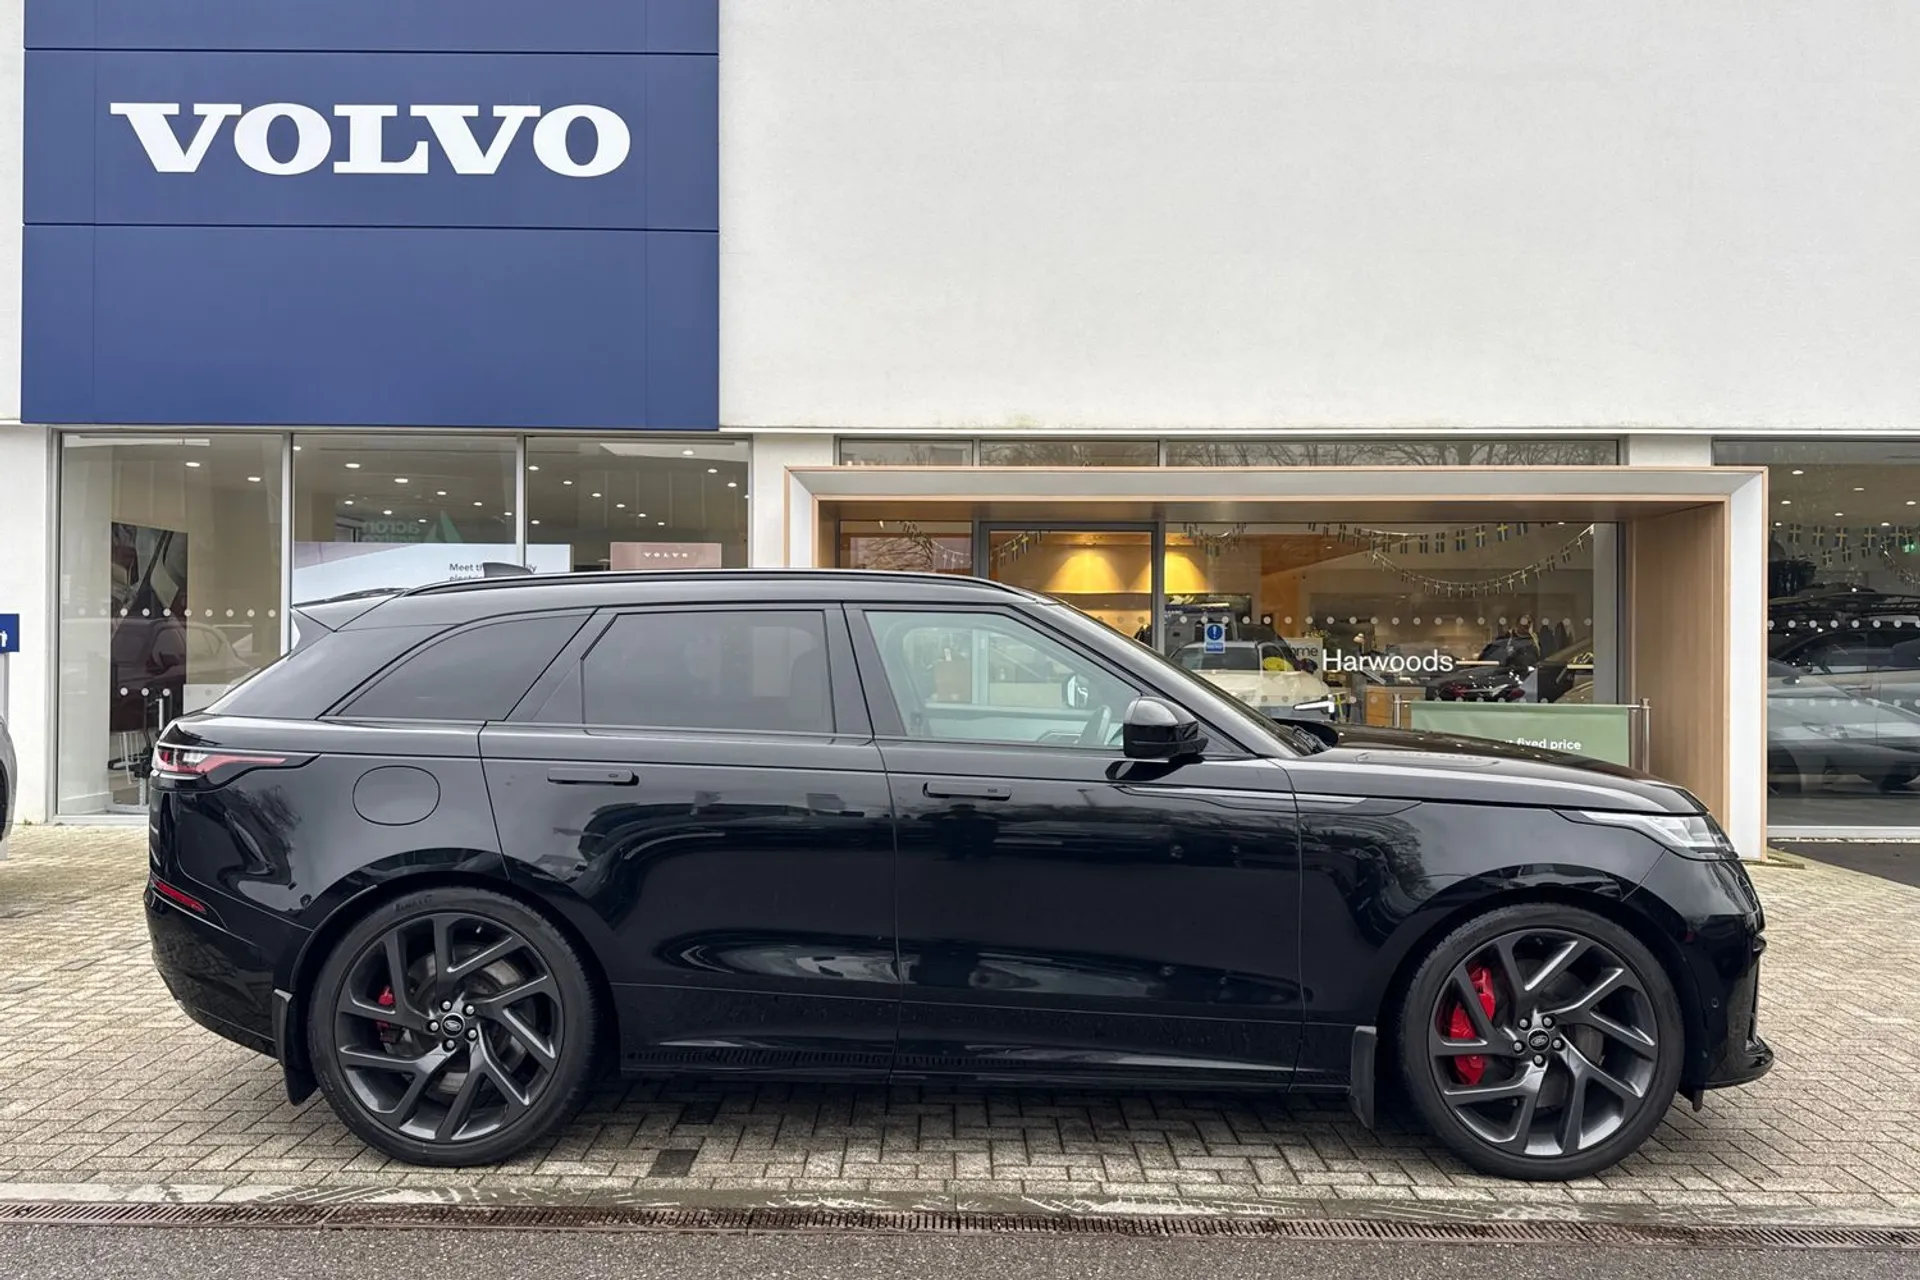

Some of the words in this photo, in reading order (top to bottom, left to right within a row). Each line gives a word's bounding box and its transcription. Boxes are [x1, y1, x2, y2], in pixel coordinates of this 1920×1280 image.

[110, 103, 631, 177] VOLVO
[449, 563, 473, 571] Meet
[1322, 649, 1453, 672] Harwoods
[1550, 739, 1582, 751] price
